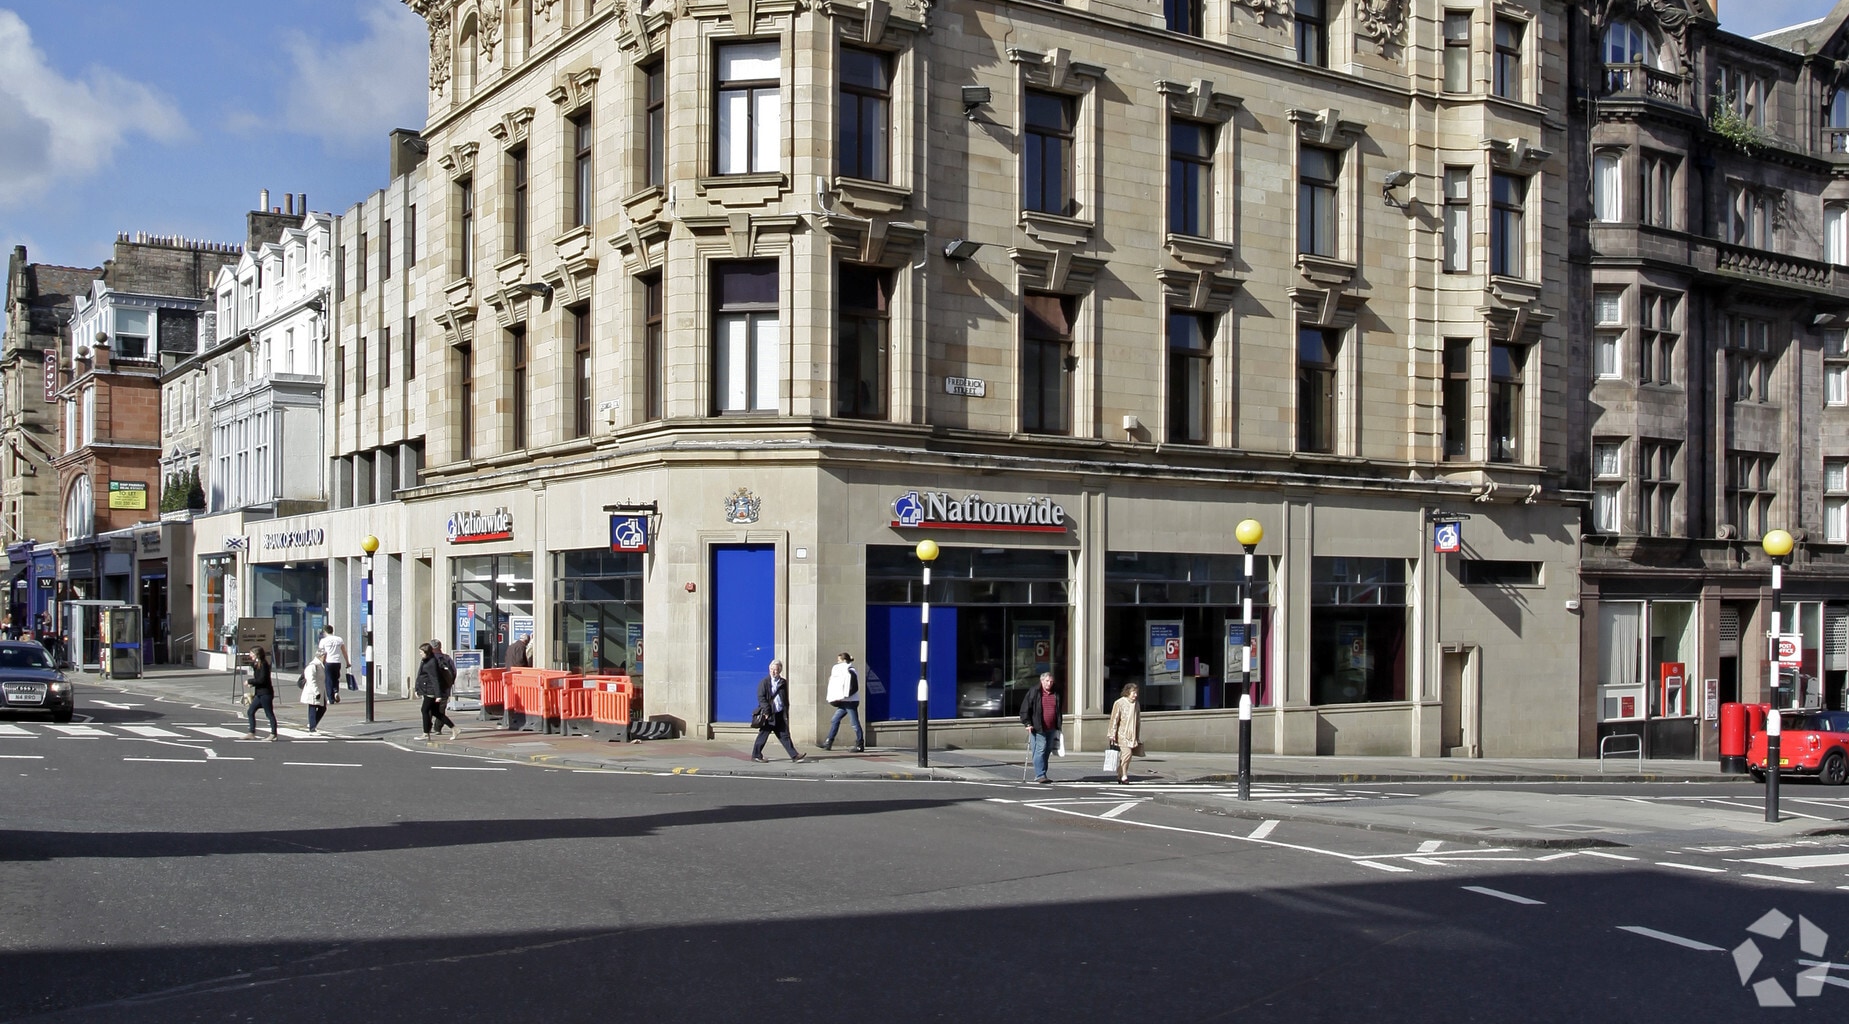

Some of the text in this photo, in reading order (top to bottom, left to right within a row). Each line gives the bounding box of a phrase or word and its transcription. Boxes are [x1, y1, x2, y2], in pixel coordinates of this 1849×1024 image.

[948, 378, 983, 388] FREDERICK
[953, 386, 977, 394] STREET
[924, 491, 1065, 525] Nationwide
[456, 507, 511, 535] Nationwide
[459, 617, 470, 628] CASH
[593, 637, 599, 653] 6
[636, 640, 643, 656] 6
